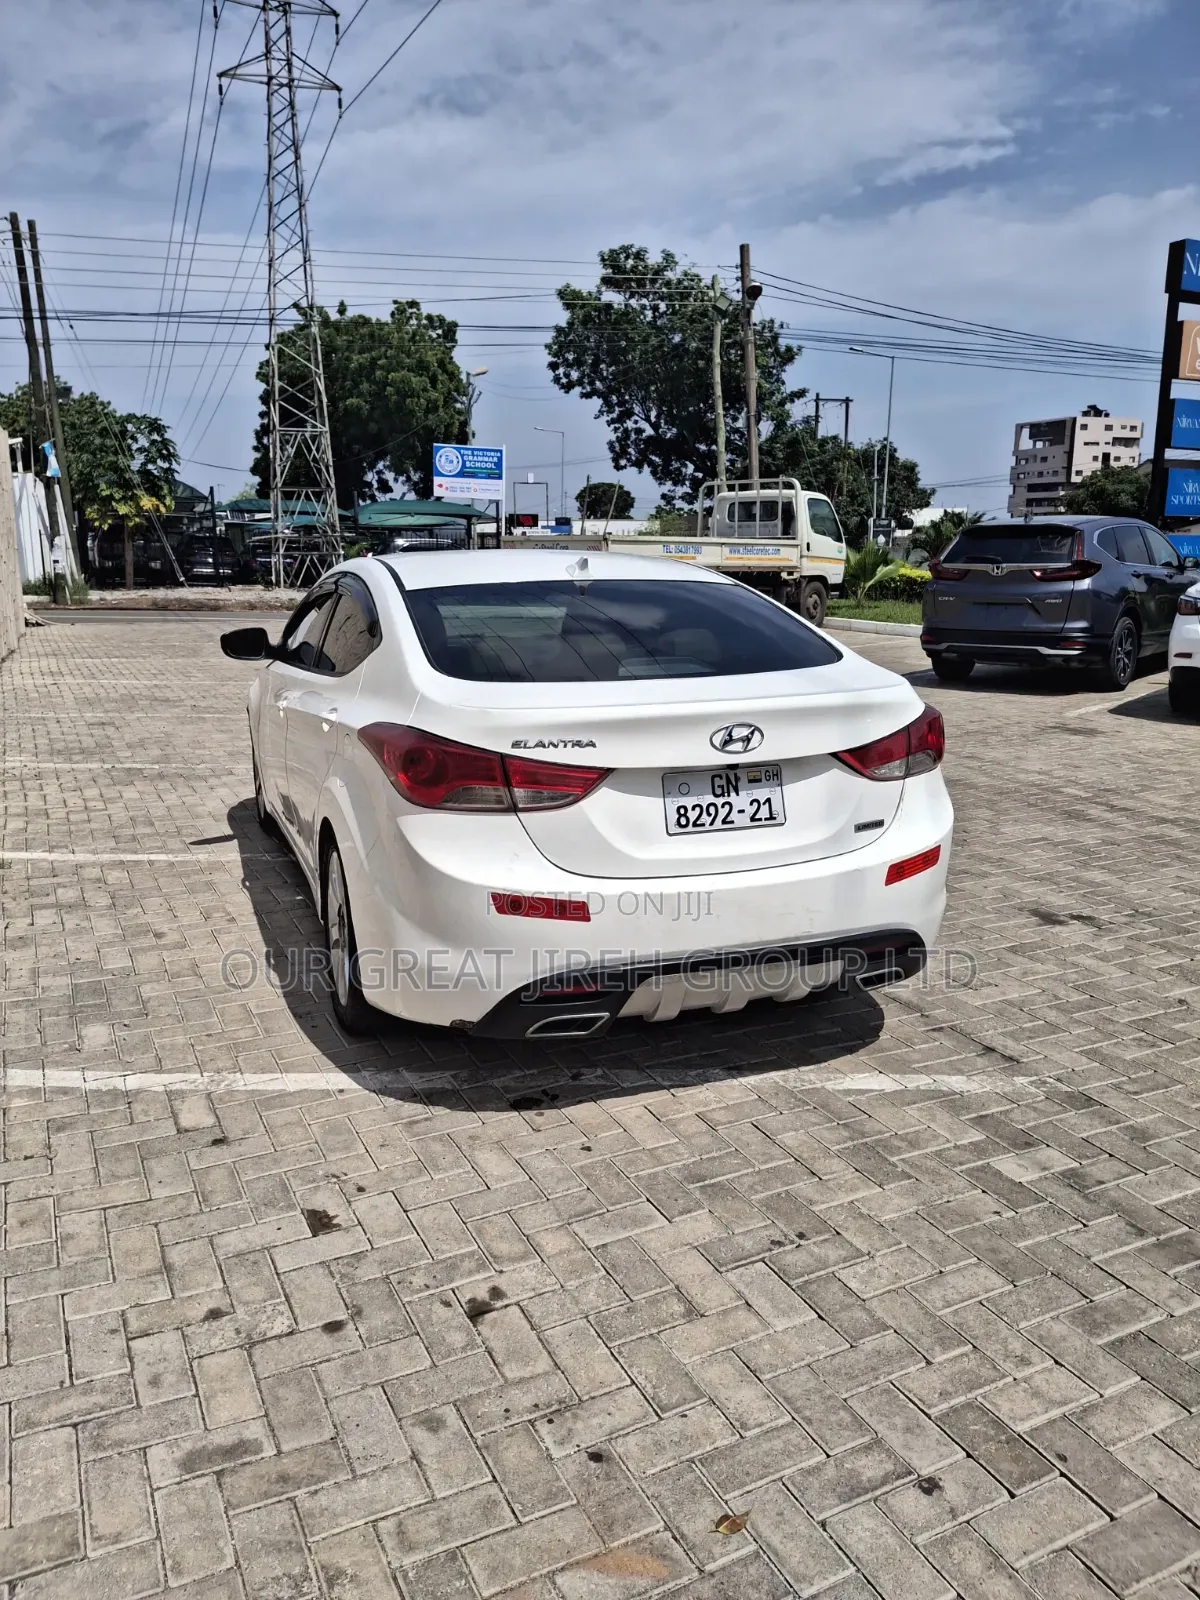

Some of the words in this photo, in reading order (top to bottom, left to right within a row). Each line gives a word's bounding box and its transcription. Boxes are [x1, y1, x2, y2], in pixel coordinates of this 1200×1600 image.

[463, 455, 498, 463] GRAMMAR
[465, 461, 497, 469] SCHOOL
[510, 738, 597, 750] ELANTRA
[711, 772, 740, 798] GN
[764, 769, 779, 782] GH
[676, 797, 777, 828] 8292-21
[857, 820, 884, 831] LIMITED
